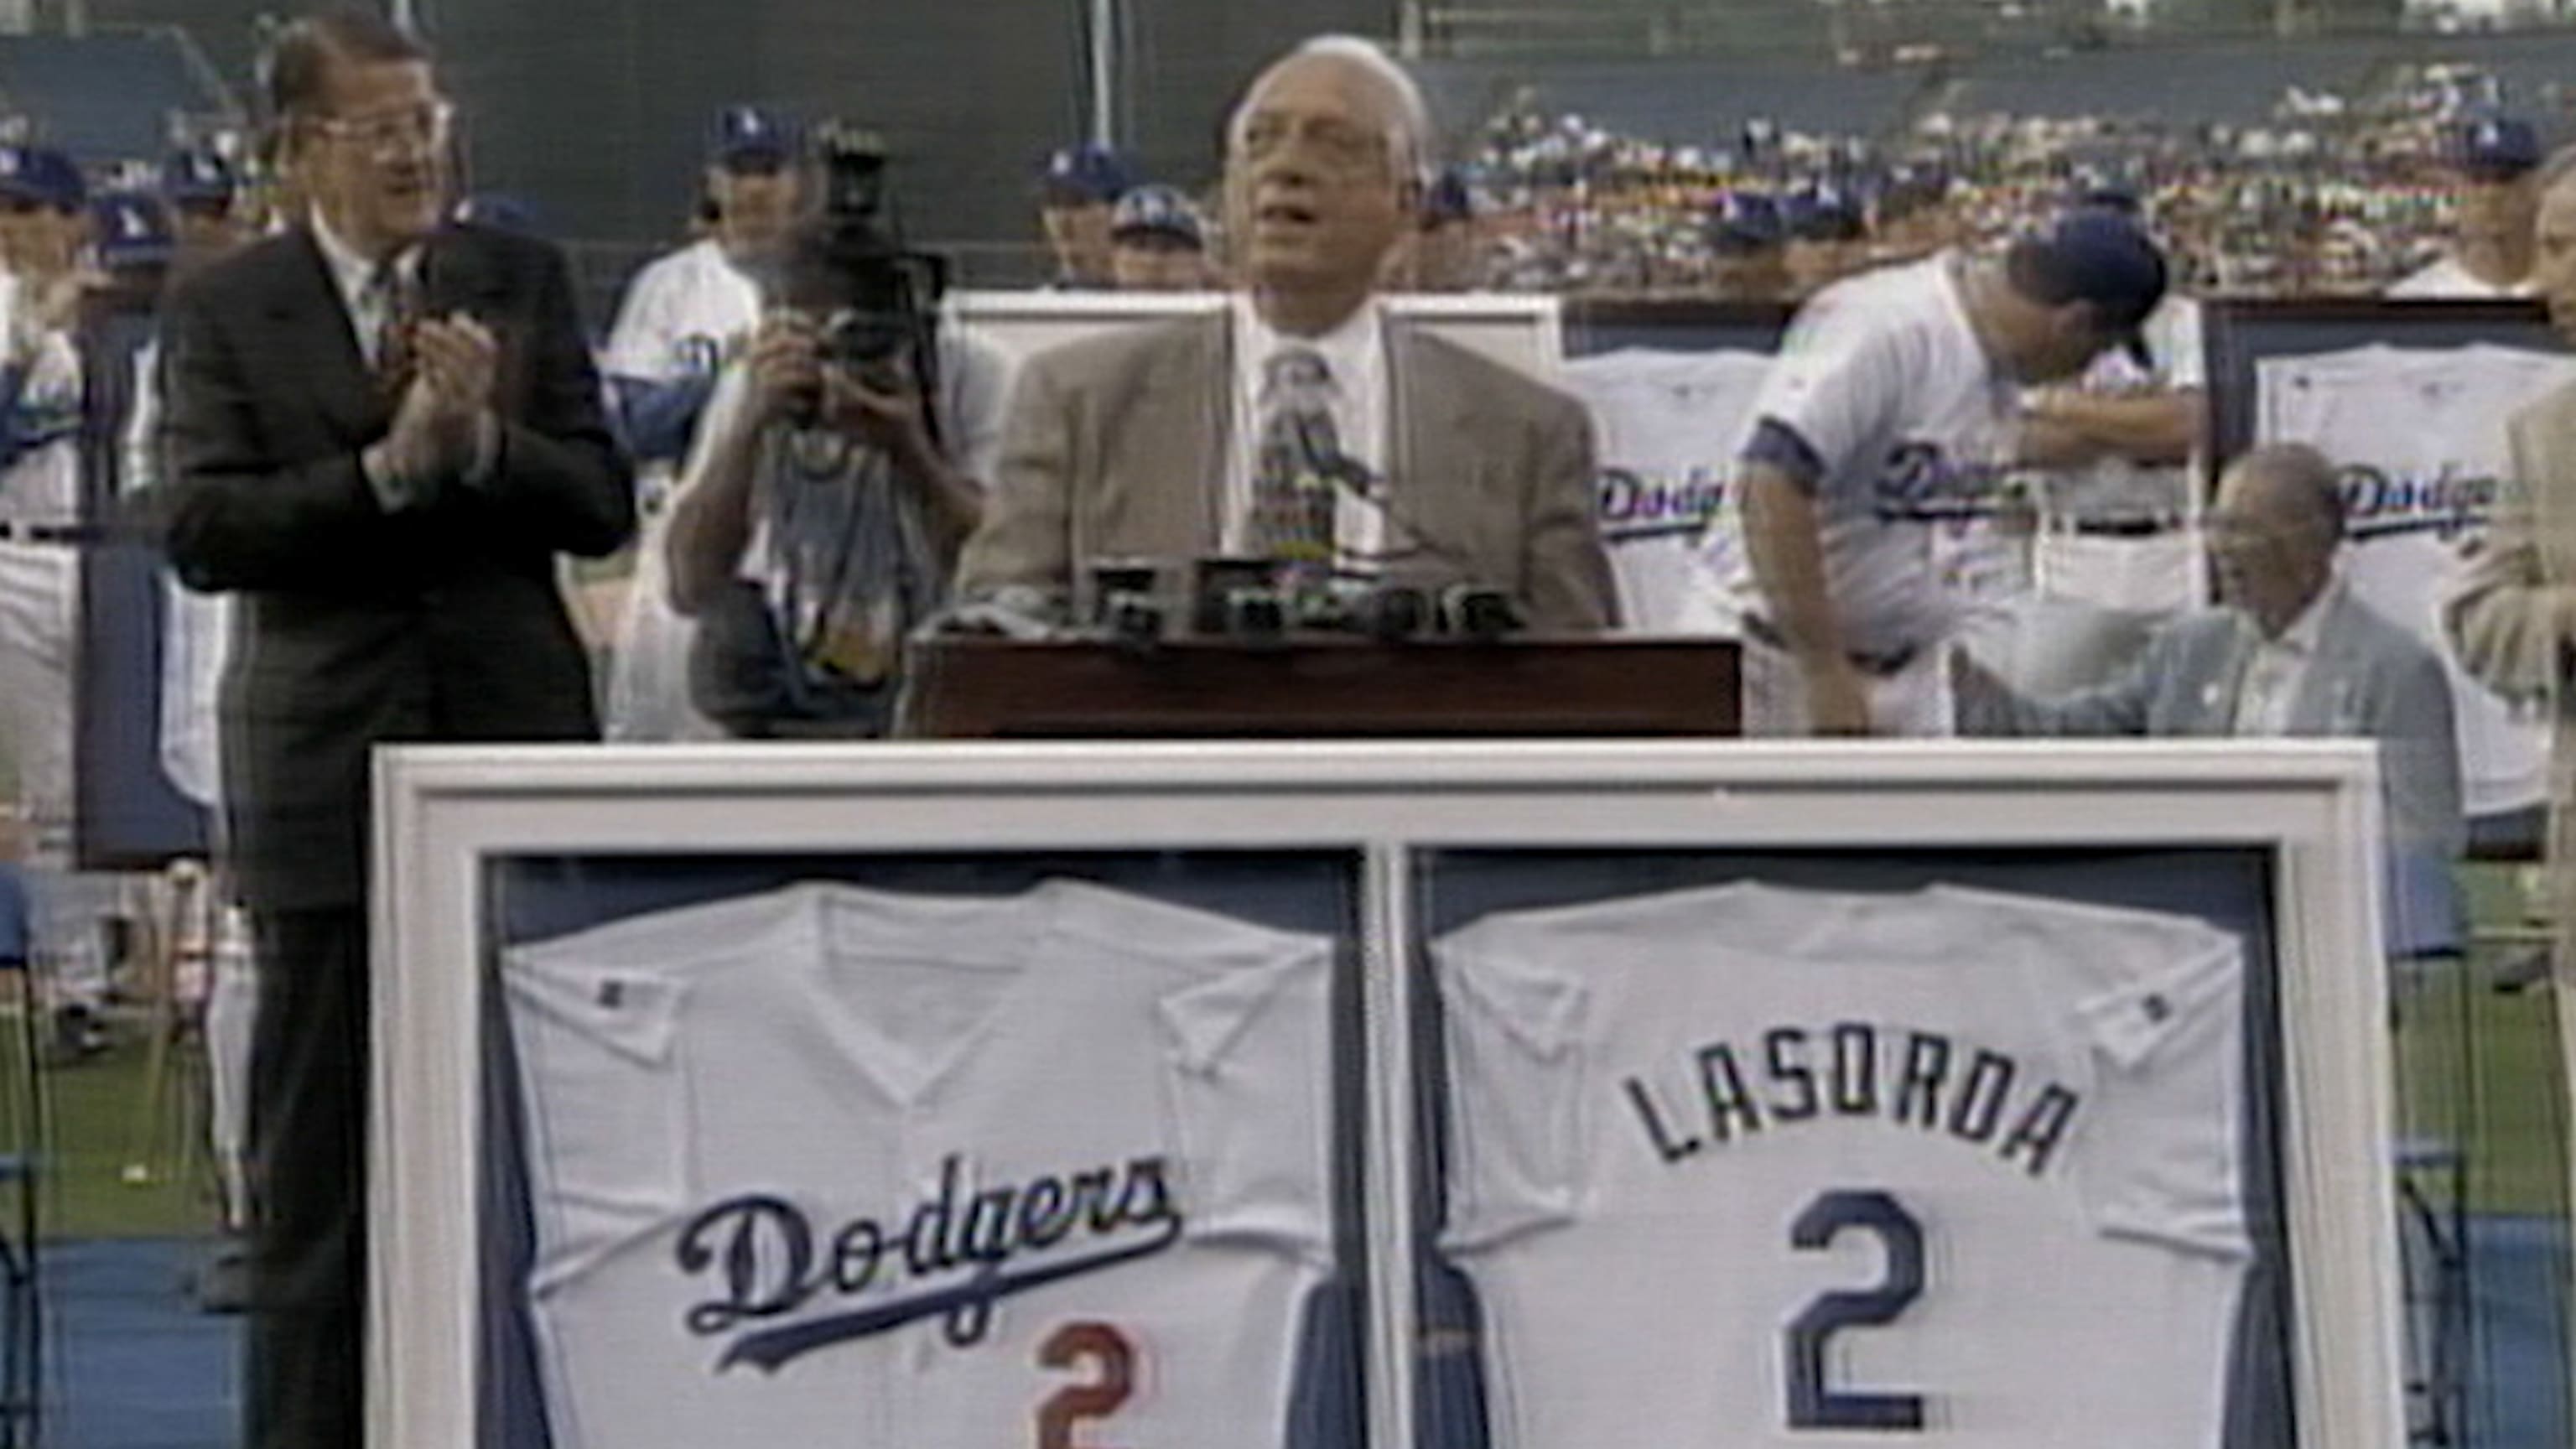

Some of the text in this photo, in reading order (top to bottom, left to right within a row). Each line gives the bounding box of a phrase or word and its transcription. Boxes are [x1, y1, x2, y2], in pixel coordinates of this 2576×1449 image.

[1623, 1023, 2080, 1176] LASORDA
[678, 1153, 1181, 1348] Dodgers
[1781, 1187, 1925, 1432] 2
[1036, 1321, 1134, 1449] 2
